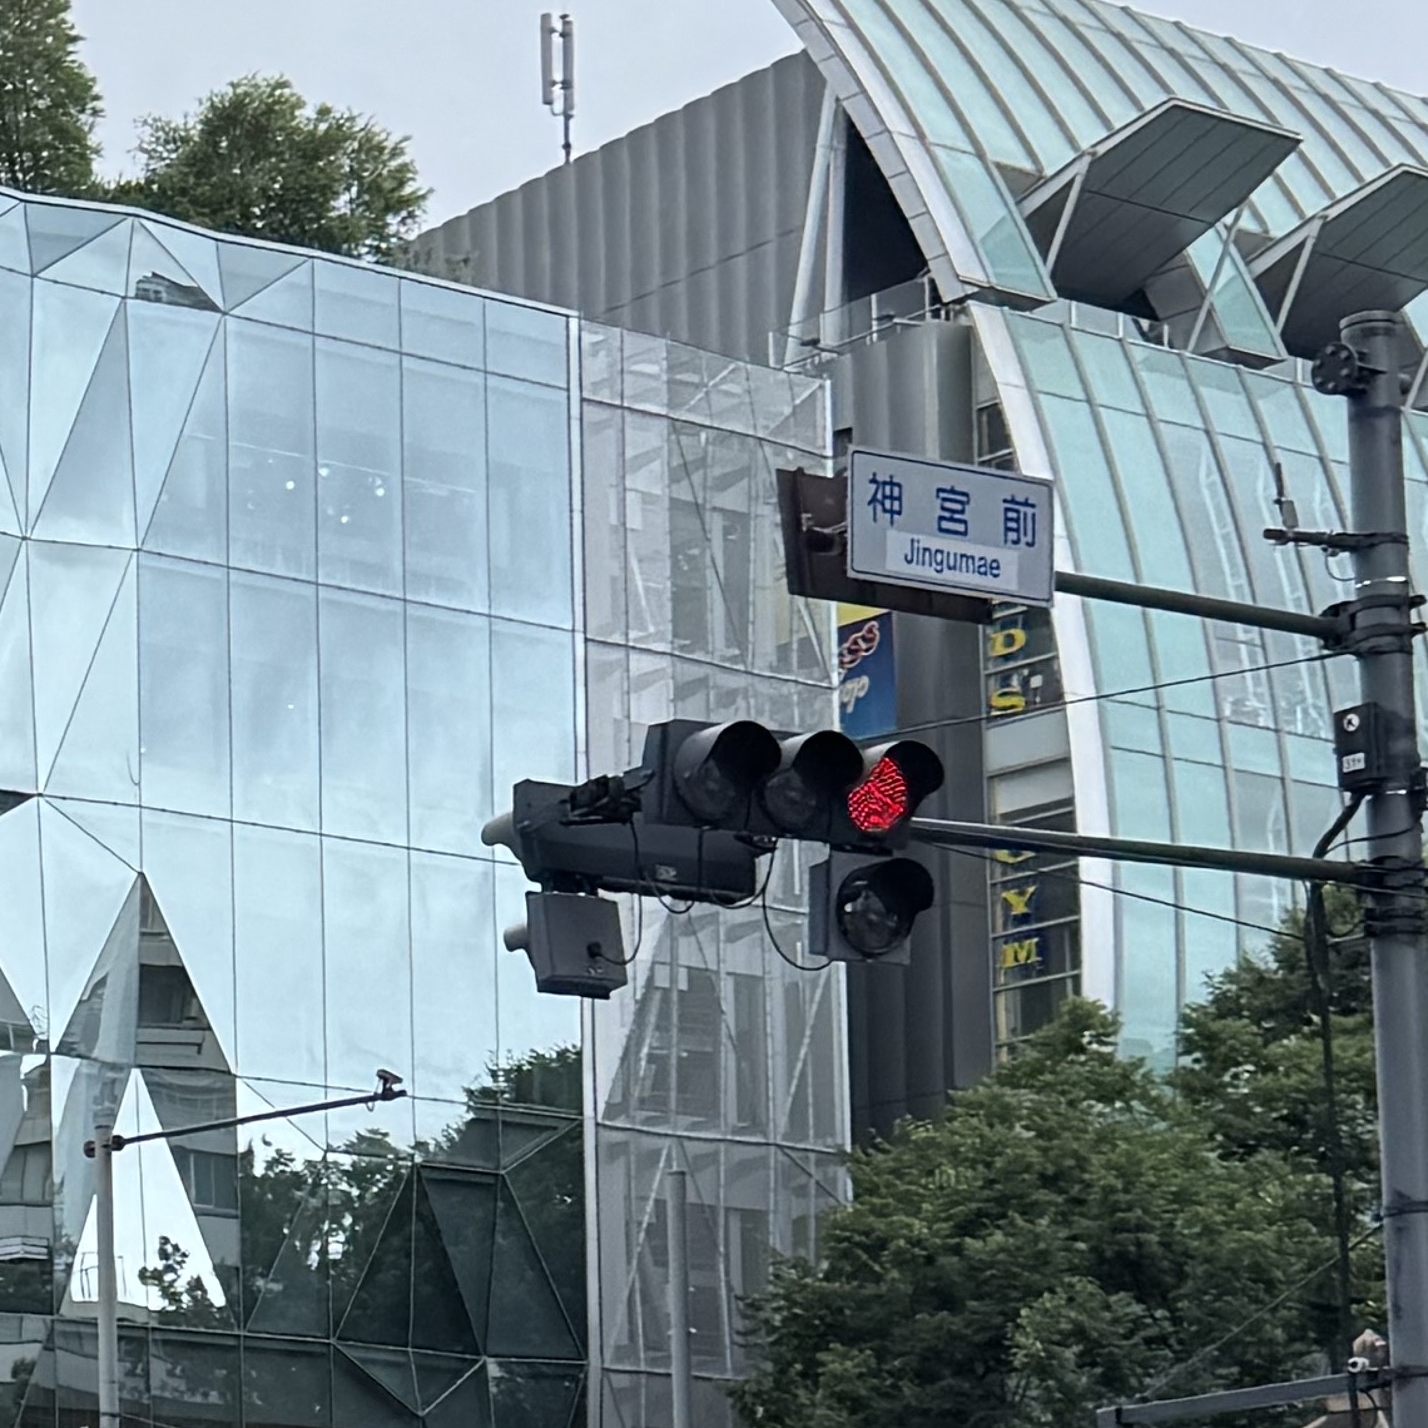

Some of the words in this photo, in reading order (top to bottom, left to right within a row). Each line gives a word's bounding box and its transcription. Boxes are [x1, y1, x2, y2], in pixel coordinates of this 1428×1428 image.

[867, 471, 1037, 548] 神宮前
[904, 537, 1001, 579] Jingumae
